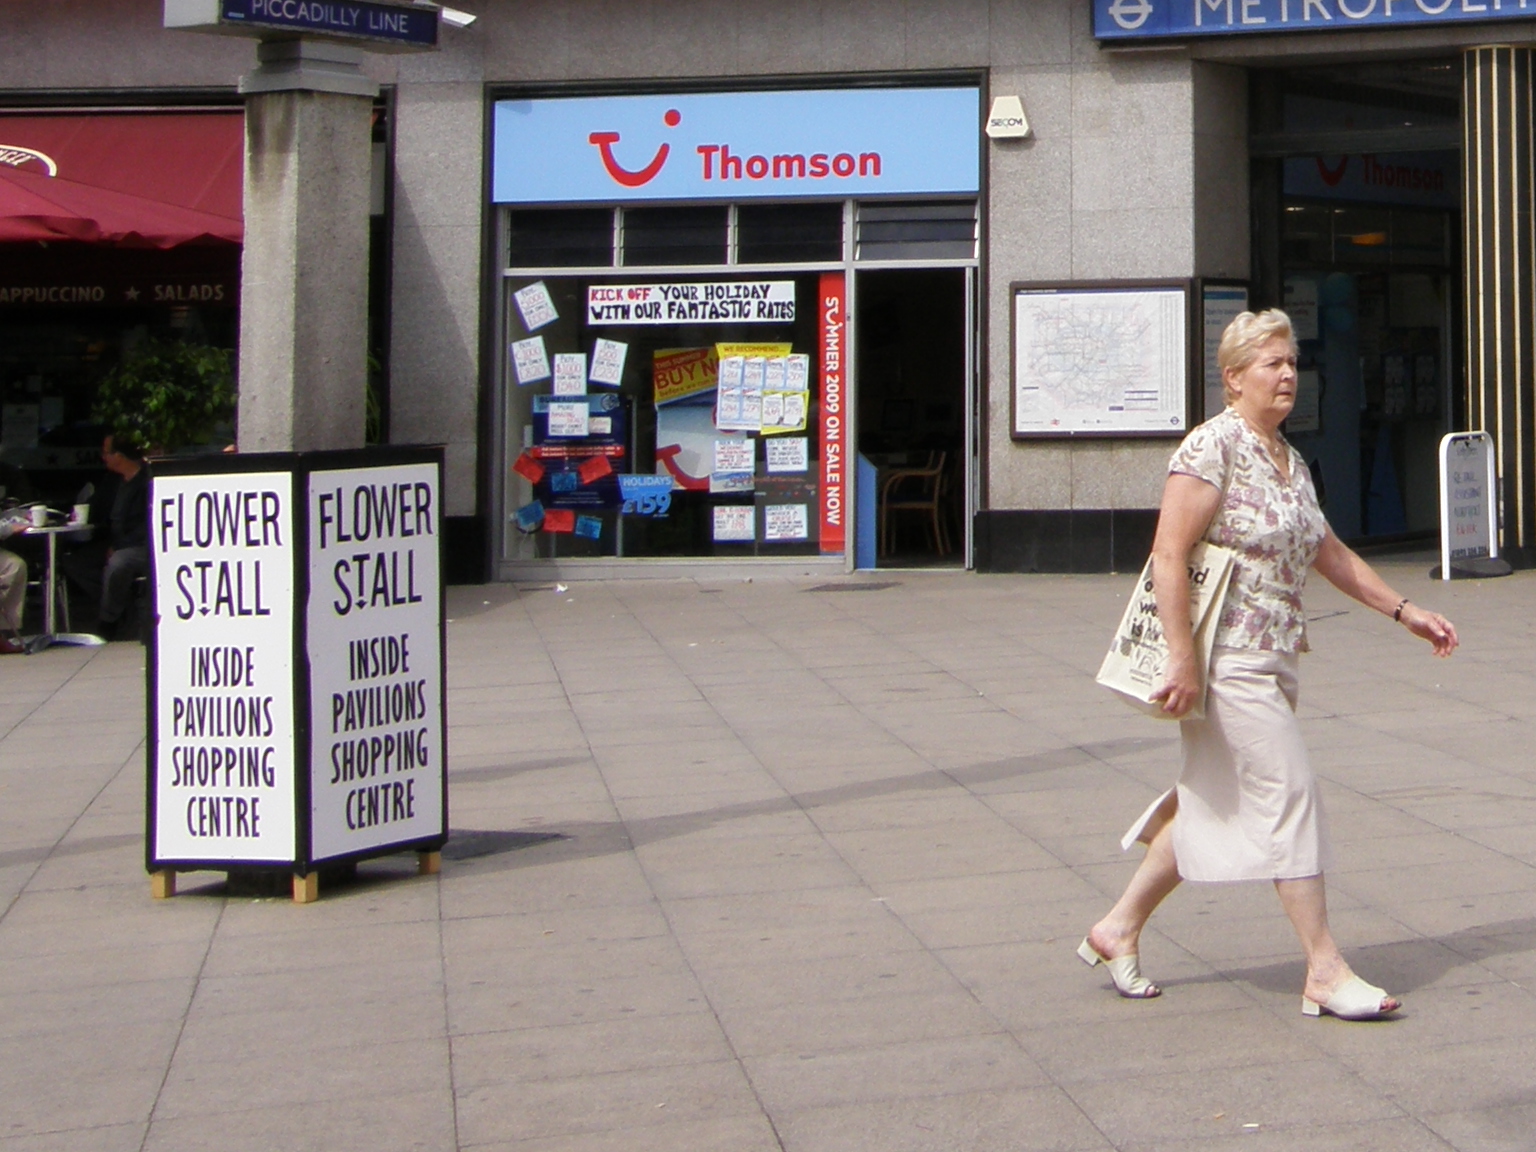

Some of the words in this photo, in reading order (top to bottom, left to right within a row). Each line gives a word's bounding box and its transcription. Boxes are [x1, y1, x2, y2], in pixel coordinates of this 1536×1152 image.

[369, 10, 410, 34] LINE
[697, 144, 882, 180] Thomson
[1361, 153, 1445, 192] Thomson
[154, 284, 224, 301] SALADS
[591, 288, 624, 301] KICK
[627, 287, 651, 301] OFF
[659, 285, 698, 300] YOUR
[705, 284, 771, 301] HOLIDAY
[591, 304, 630, 320] WITH
[634, 302, 662, 319] OUR
[825, 296, 843, 372] SUMMER
[655, 362, 696, 390] BUY
[826, 374, 840, 414] 2009
[826, 415, 840, 440] ON
[623, 476, 671, 487] HOLIDAYS
[826, 443, 840, 483] SALE
[160, 490, 283, 553] FLOWER
[318, 481, 433, 550] FLOWER
[621, 492, 672, 515] £159
[827, 485, 841, 525] NOW
[175, 560, 271, 620] STALL
[333, 550, 423, 616] STALL
[190, 646, 255, 688] INSIDE
[349, 633, 410, 681] INSIDE
[172, 695, 274, 738] PAVILIONS
[331, 679, 427, 734] PAVILIONS
[171, 746, 276, 788] SHOPPING
[330, 727, 429, 785] SHOPPING
[186, 796, 260, 838] CENTRE
[346, 778, 415, 830] CENTRE
